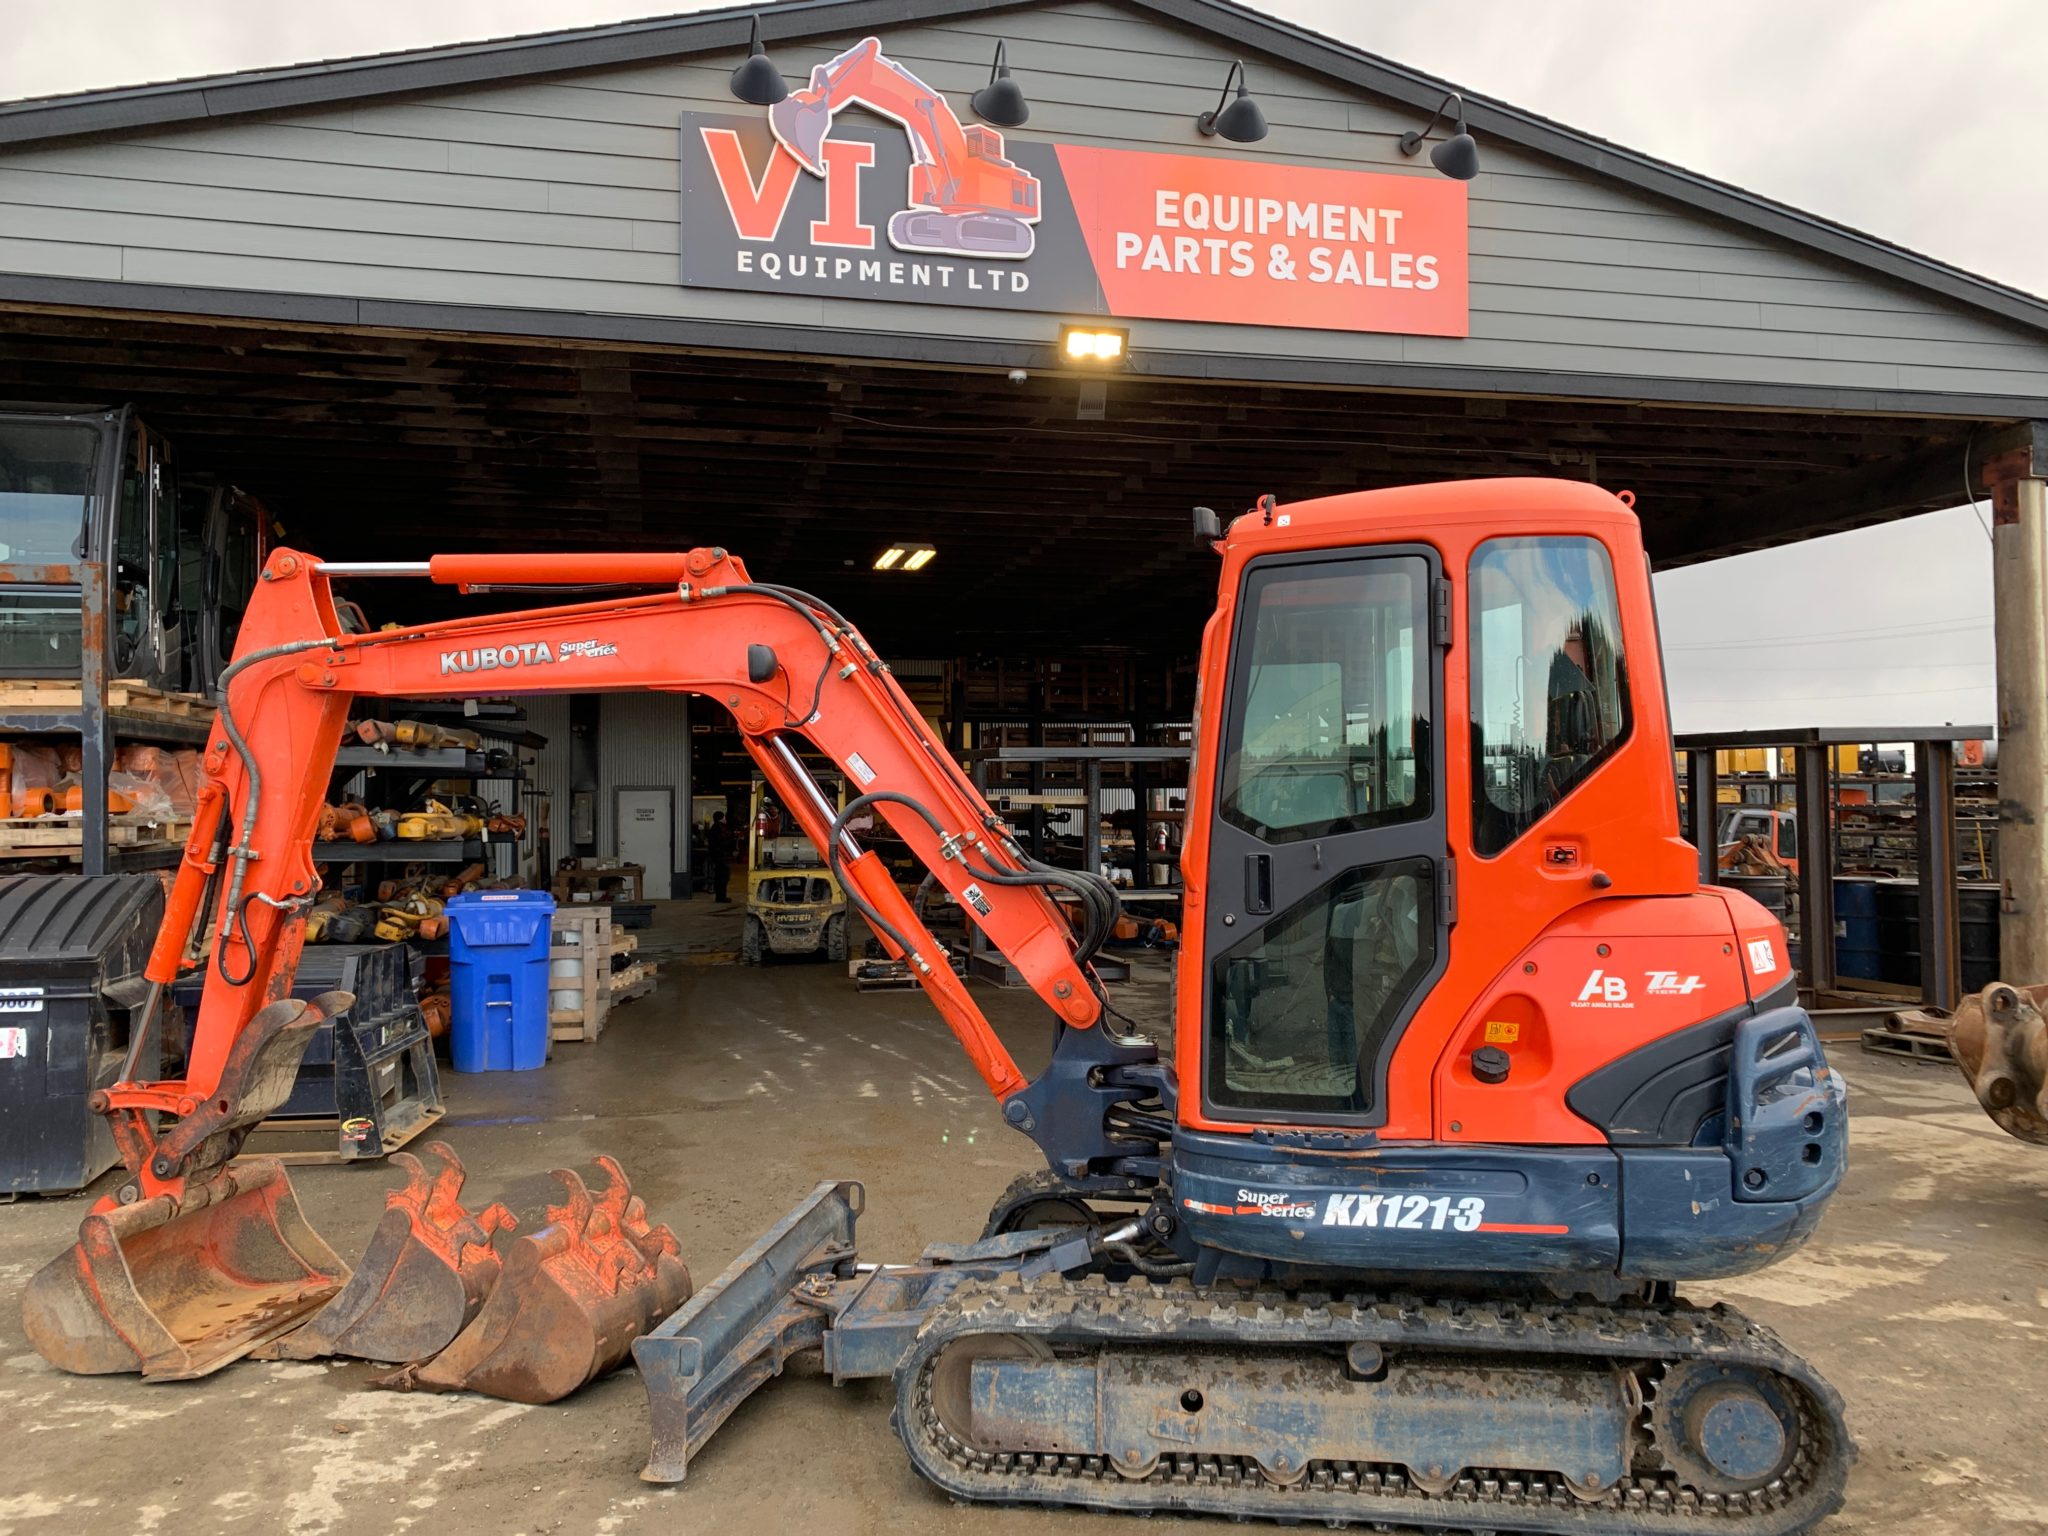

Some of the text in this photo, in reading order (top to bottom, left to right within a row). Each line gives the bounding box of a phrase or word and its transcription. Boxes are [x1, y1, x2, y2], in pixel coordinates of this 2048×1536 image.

[699, 127, 876, 250] VI
[1156, 189, 1403, 245] EQUIPMENT
[737, 250, 1030, 293] EQUIPMENT LTD
[1116, 231, 1440, 290] PARTS & SALES
[440, 641, 555, 675] KUBOTA
[559, 639, 599, 654] Super
[1577, 969, 1628, 1001] AB
[1236, 1188, 1288, 1205] Super
[1260, 1201, 1315, 1219] Series
[1323, 1193, 1486, 1232] KX121-3
